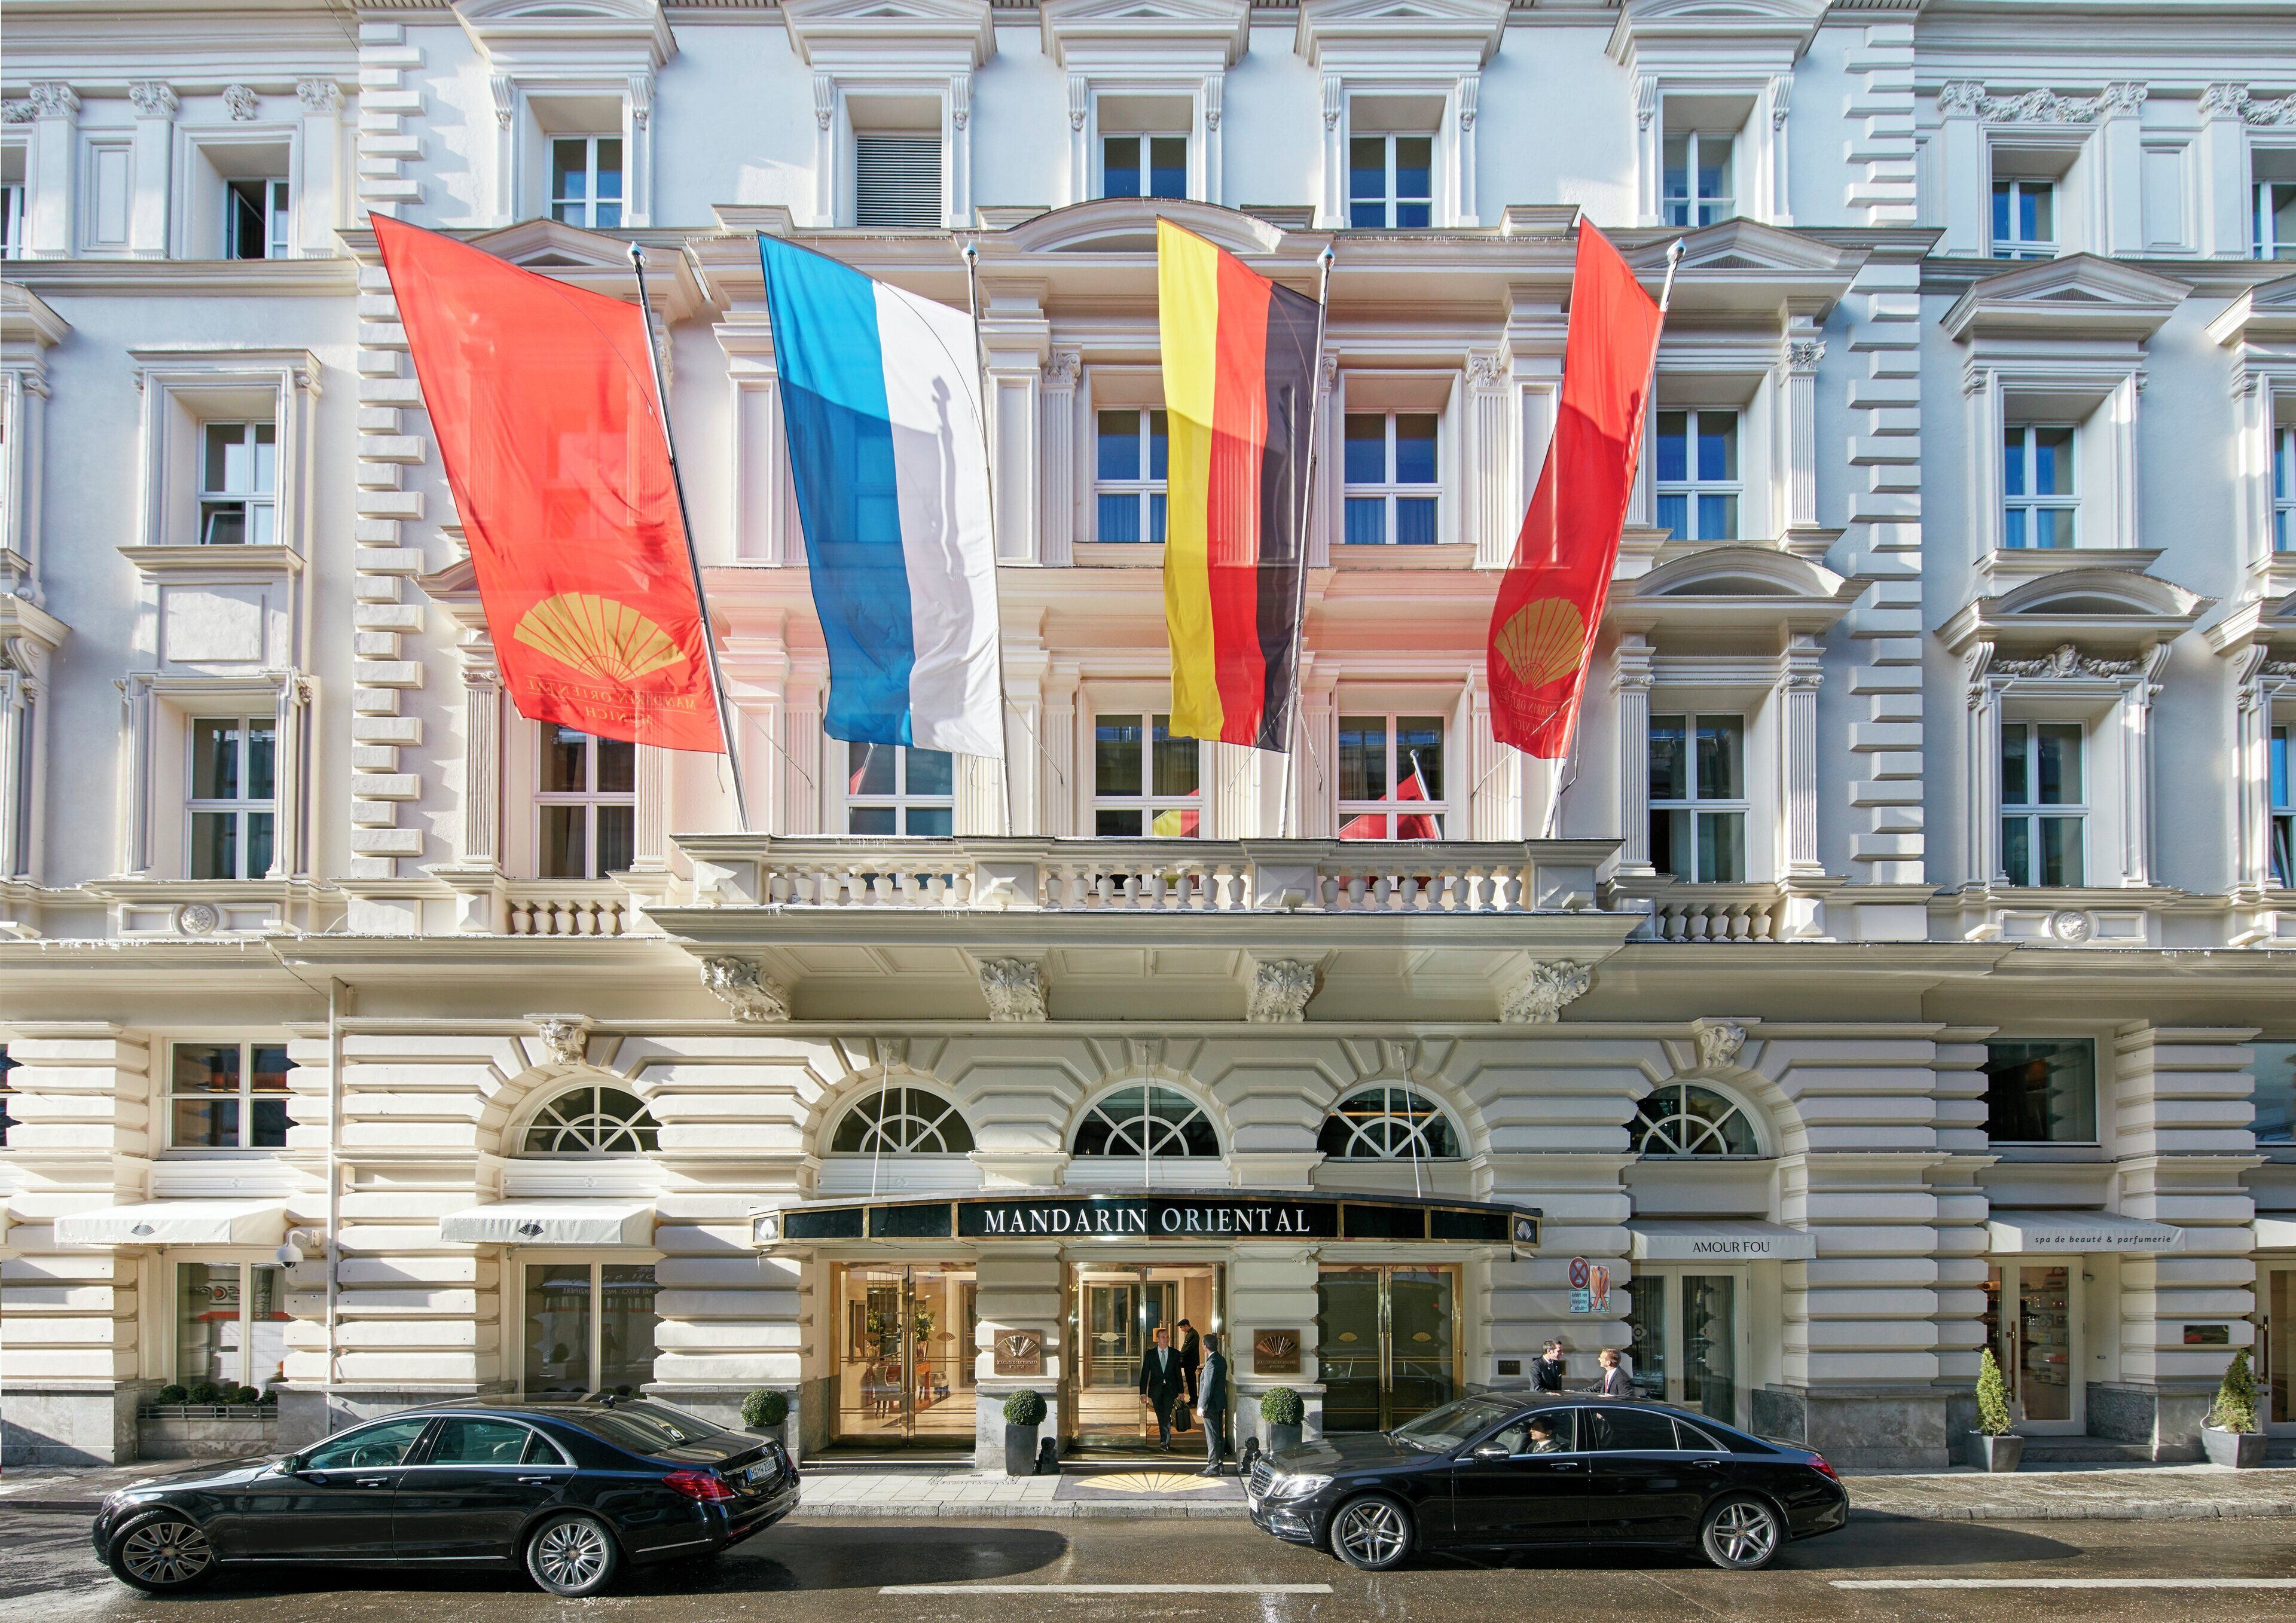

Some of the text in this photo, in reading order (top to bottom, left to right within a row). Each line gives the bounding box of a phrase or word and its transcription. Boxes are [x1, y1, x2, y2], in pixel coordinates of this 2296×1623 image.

[984, 1208, 1310, 1233] MANDARIN ORIENTAL
[2117, 1235, 2172, 1245] parfumerie
[1693, 1242, 1770, 1252] AMOUR FOU
